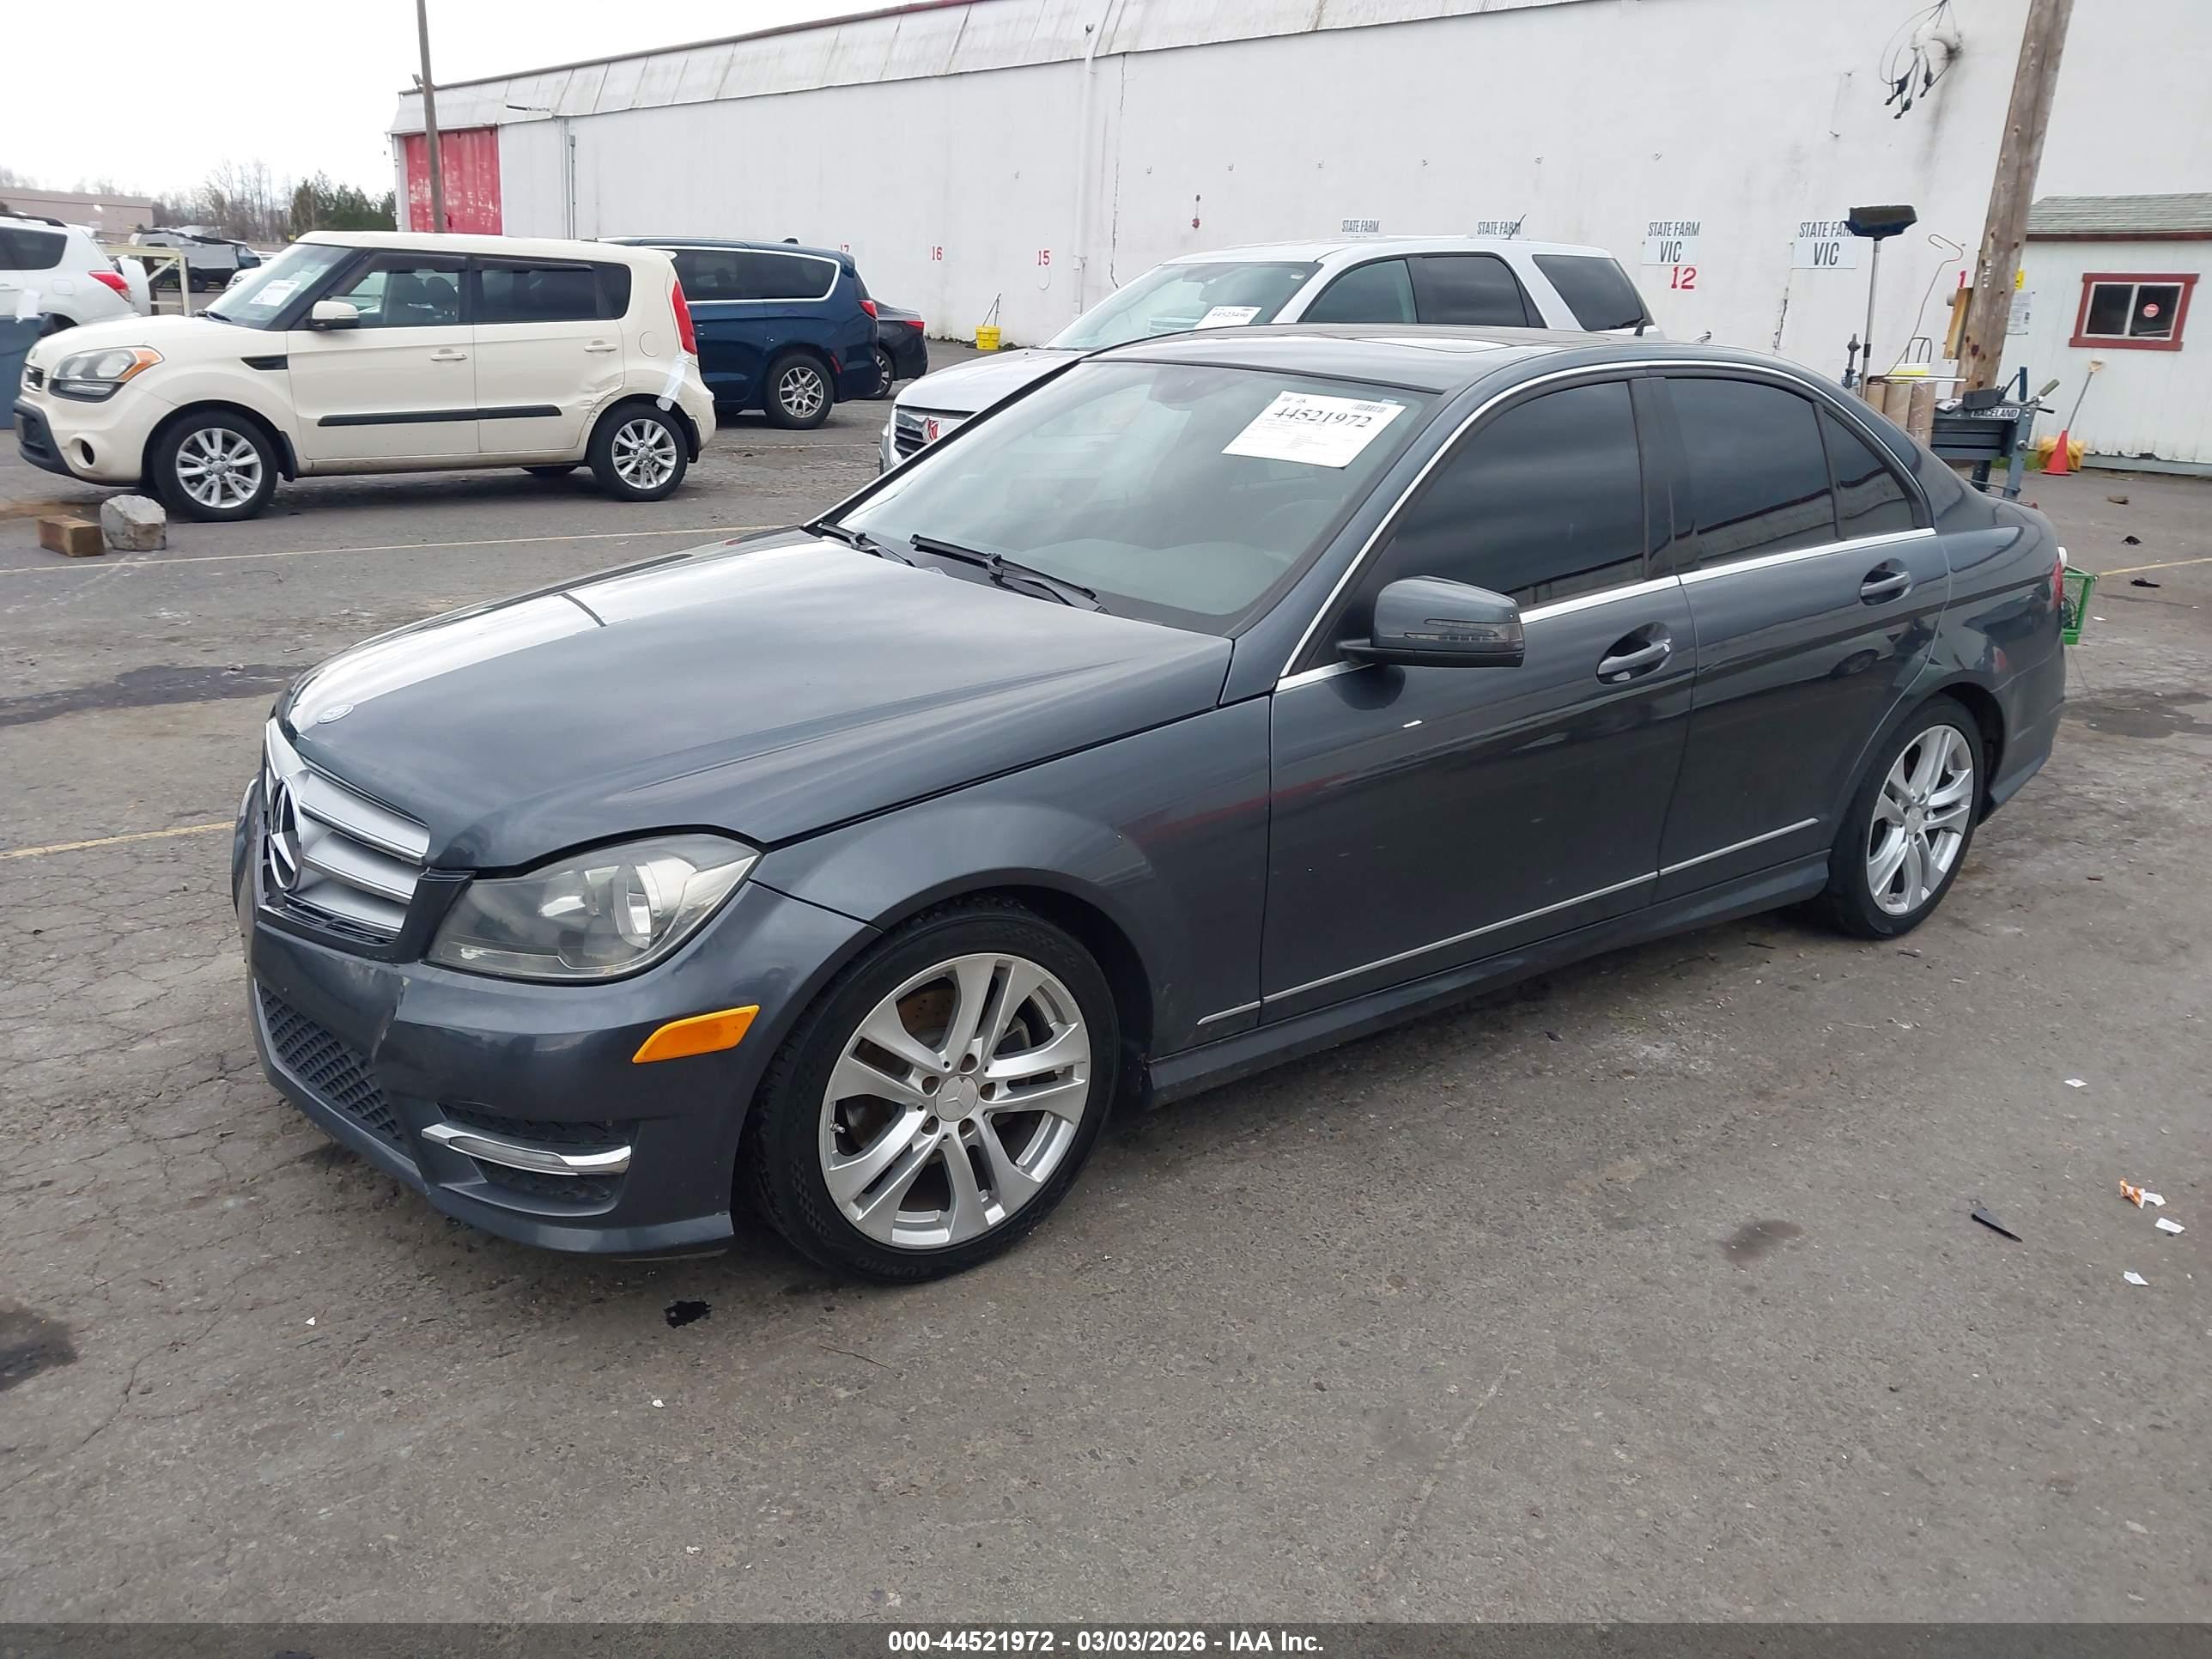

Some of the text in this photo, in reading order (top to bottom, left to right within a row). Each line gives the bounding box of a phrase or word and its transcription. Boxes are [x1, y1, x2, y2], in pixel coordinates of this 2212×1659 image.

[1341, 220, 1379, 234] STATE FARM
[1477, 221, 1522, 235] STATE FARM
[1648, 222, 1700, 237] STATE FARM
[1799, 221, 1855, 238] STATE FAR
[932, 246, 943, 261] 16
[1037, 250, 1050, 266] 15
[1659, 241, 1682, 263] VIC
[1814, 241, 1839, 266] VIC
[1671, 266, 1697, 290] 12
[1273, 407, 1373, 428] 44521972
